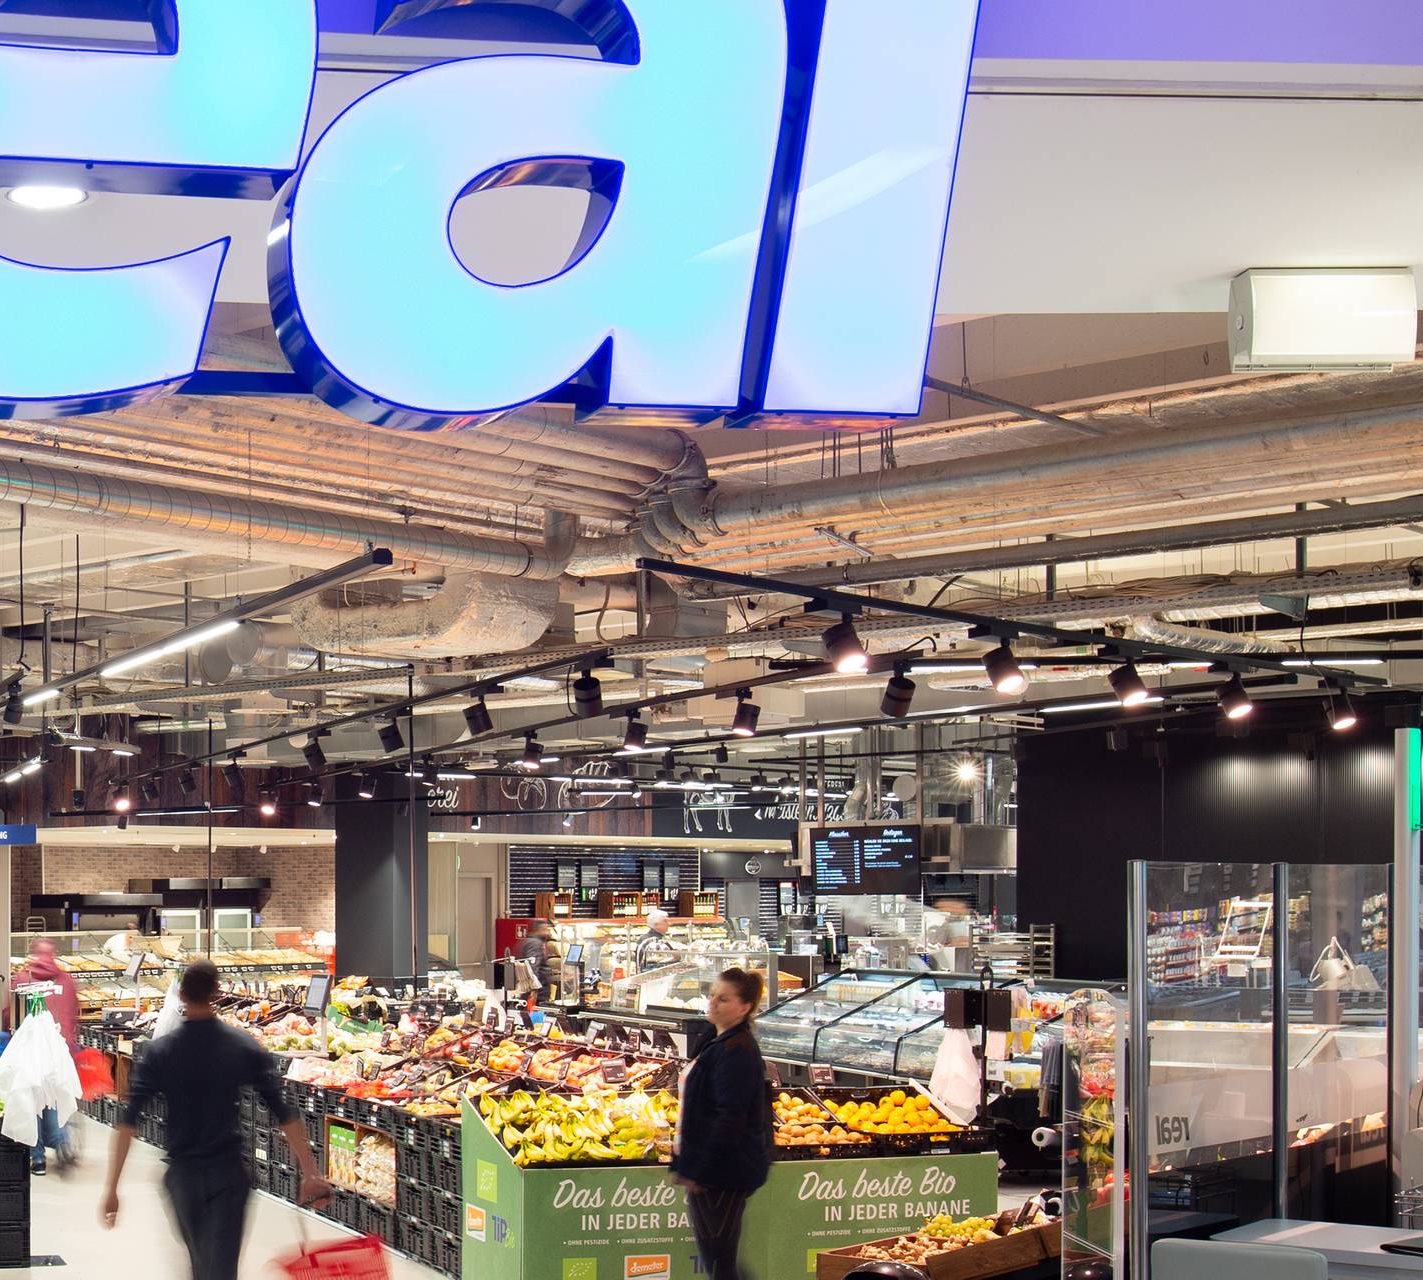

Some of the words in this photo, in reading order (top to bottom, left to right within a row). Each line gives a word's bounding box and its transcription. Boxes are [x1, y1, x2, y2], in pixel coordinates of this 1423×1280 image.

[553, 1178, 605, 1209] Das
[611, 1176, 676, 1208] beste
[798, 1171, 847, 1201] Das
[852, 1167, 913, 1199] beste
[919, 1165, 956, 1195] Bio
[581, 1214, 600, 1231] IN
[606, 1212, 660, 1231] JEDER
[824, 1206, 842, 1222] IN
[848, 1203, 898, 1221] JEDER
[904, 1199, 970, 1218] BANANE
[630, 1260, 664, 1273] demeter
